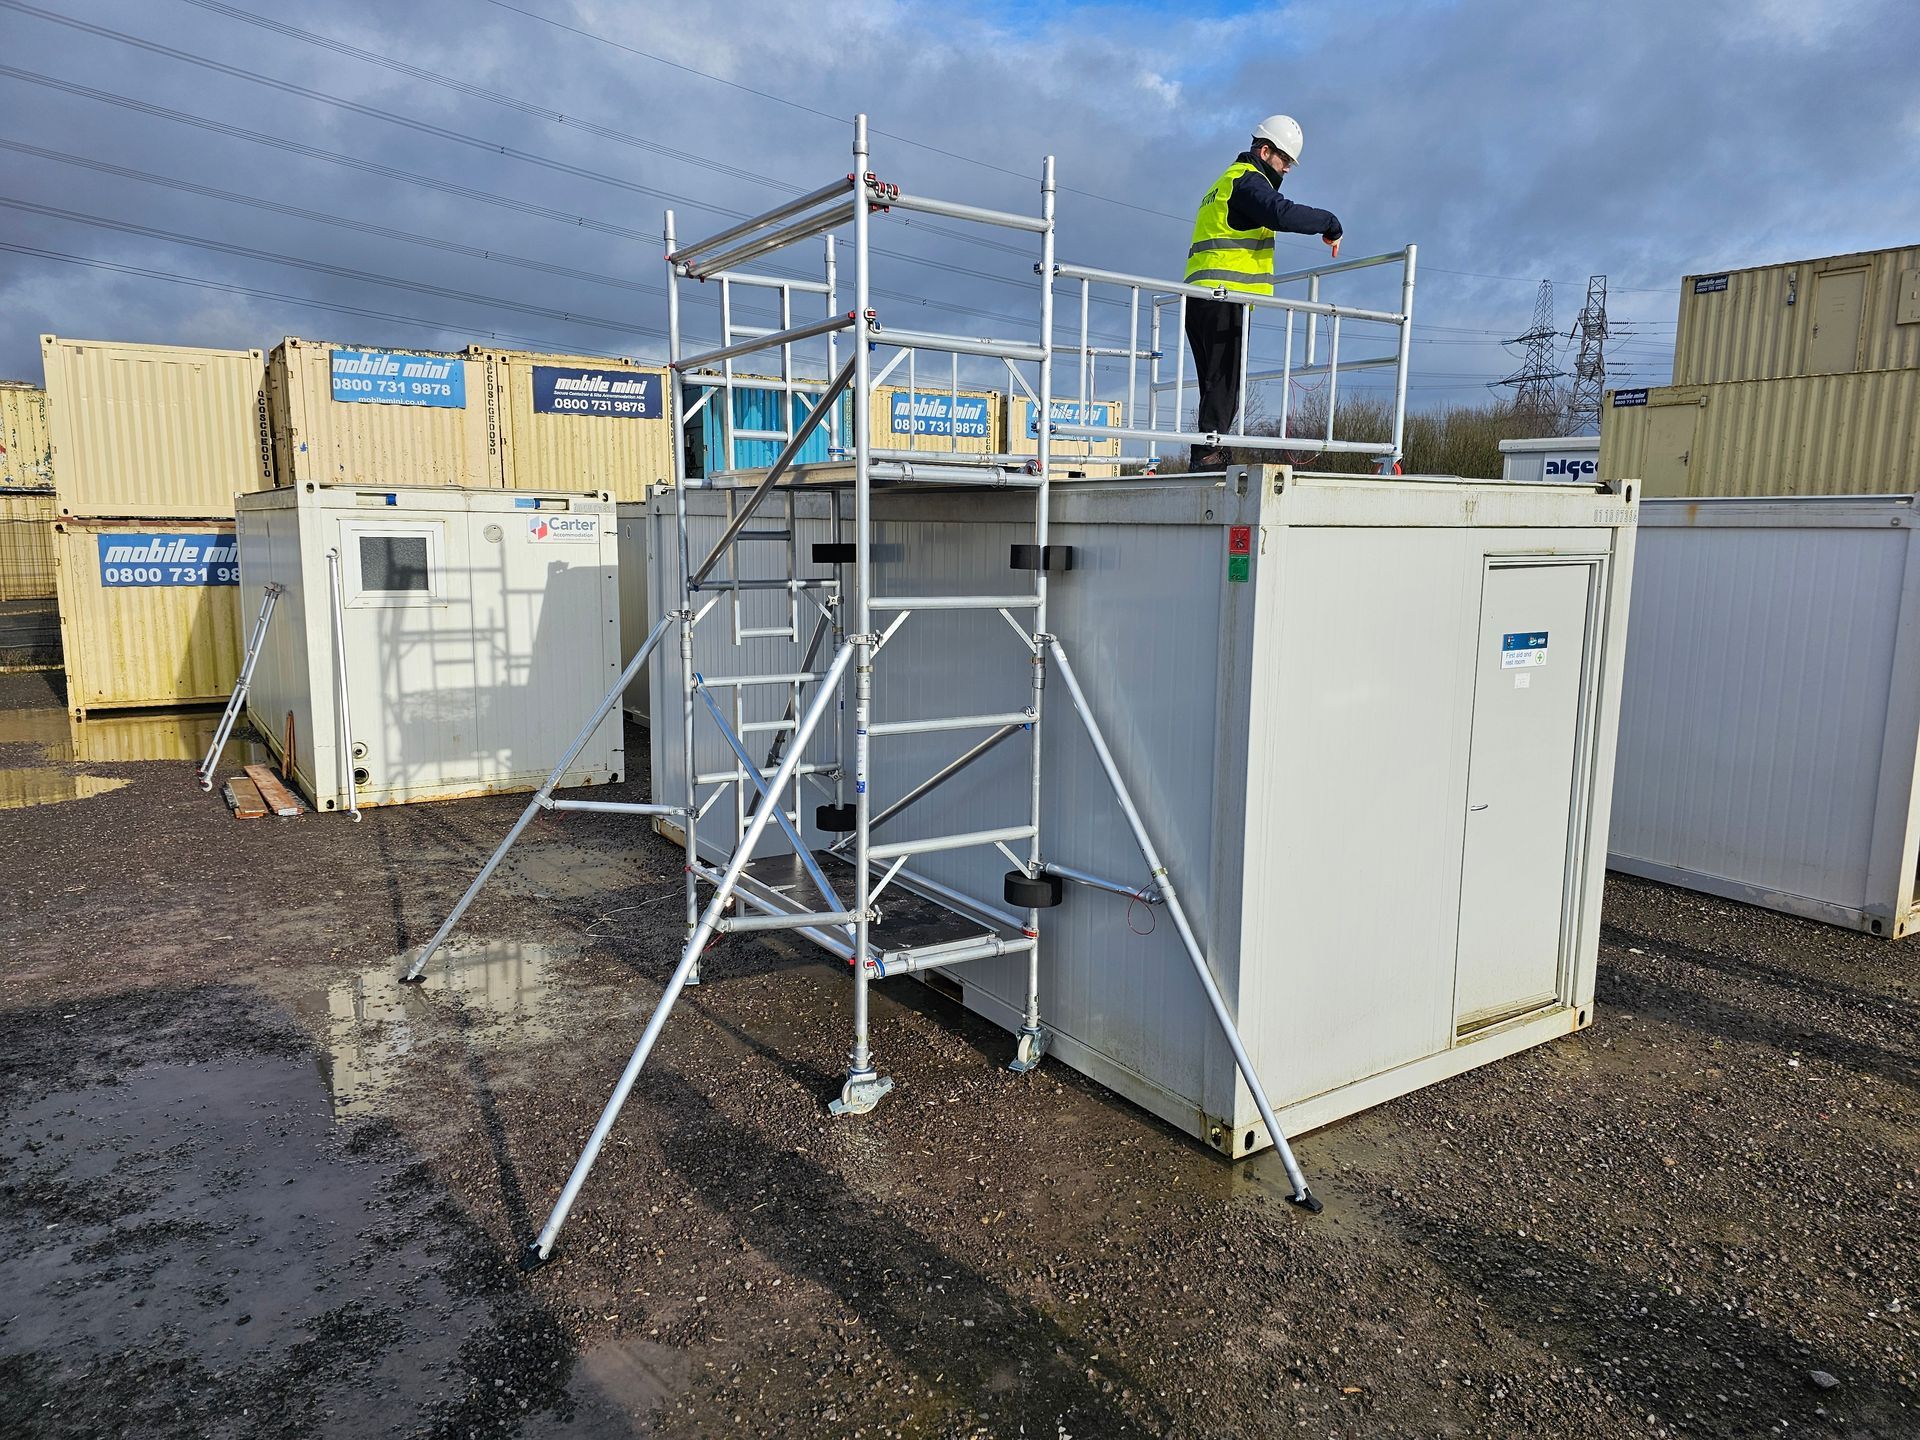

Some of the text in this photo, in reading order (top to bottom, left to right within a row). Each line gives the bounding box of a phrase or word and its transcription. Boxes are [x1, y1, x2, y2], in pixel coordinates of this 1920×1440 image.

[402, 361, 452, 379] mini
[333, 378, 452, 396] 0800 731 9878
[555, 374, 648, 395] mobile mini
[358, 397, 428, 406] mobilemini.co.uk
[555, 398, 646, 413] 0800 731 9878
[929, 420, 951, 433] 731
[956, 422, 984, 434] 9878
[549, 517, 596, 531] Carter
[104, 538, 240, 563] mobile mi
[105, 567, 162, 583] 0800
[169, 567, 208, 583] 731
